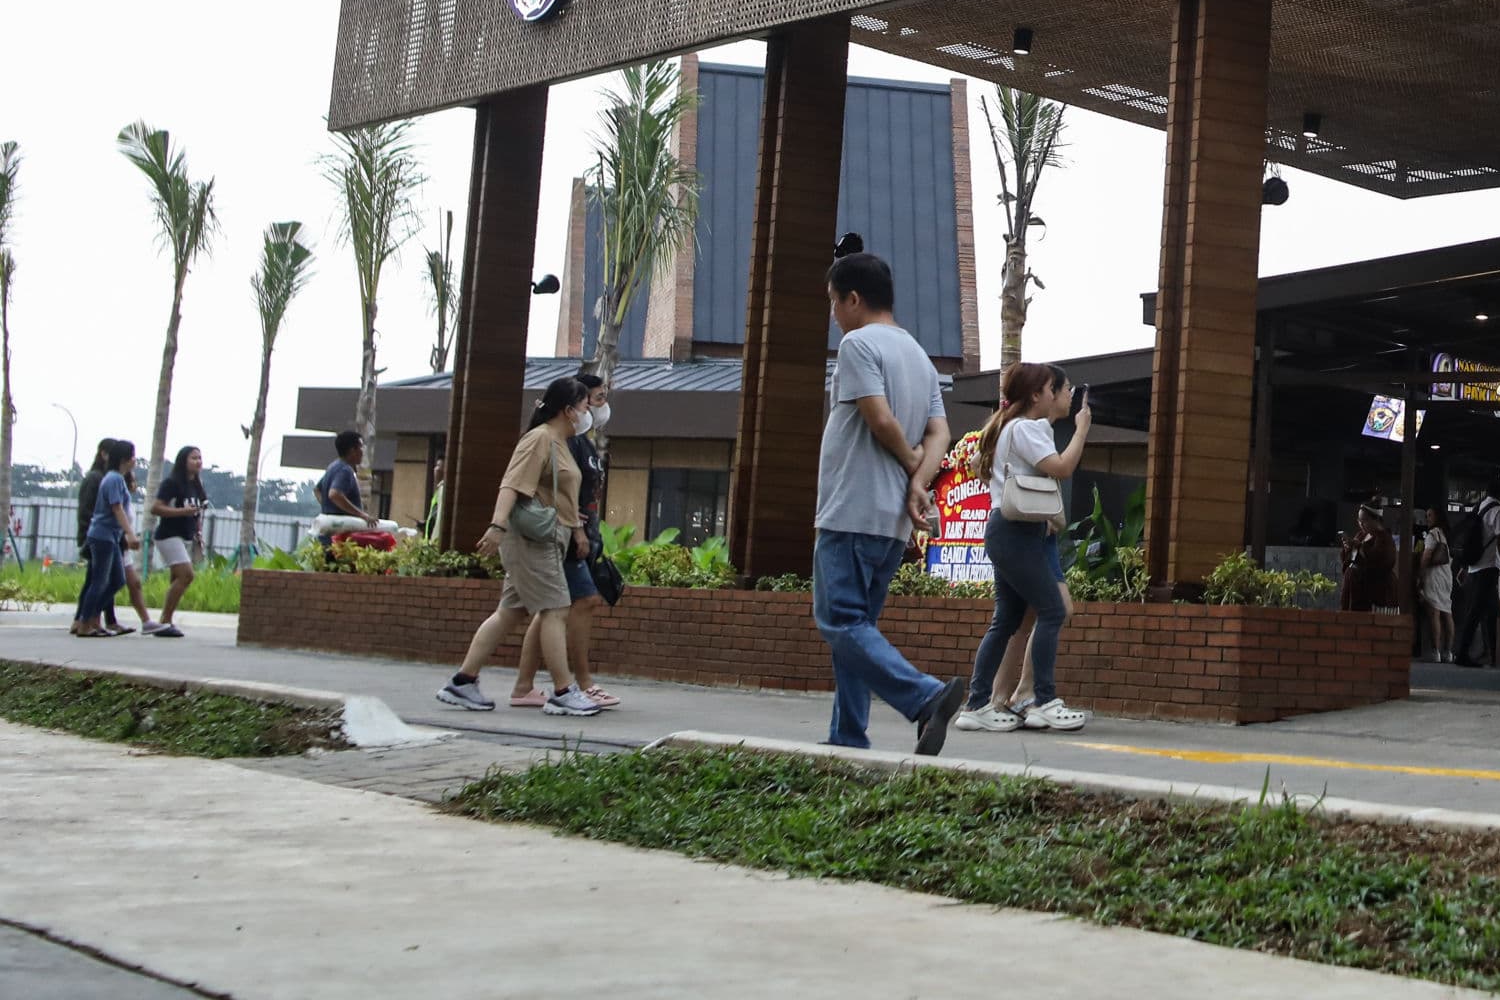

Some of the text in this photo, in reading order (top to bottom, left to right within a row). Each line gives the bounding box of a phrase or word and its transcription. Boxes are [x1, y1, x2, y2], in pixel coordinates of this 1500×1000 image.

[947, 479, 990, 506] CONGRA
[960, 509, 986, 520] GRAND
[944, 521, 965, 539] RANS
[941, 546, 967, 563] GANDI
